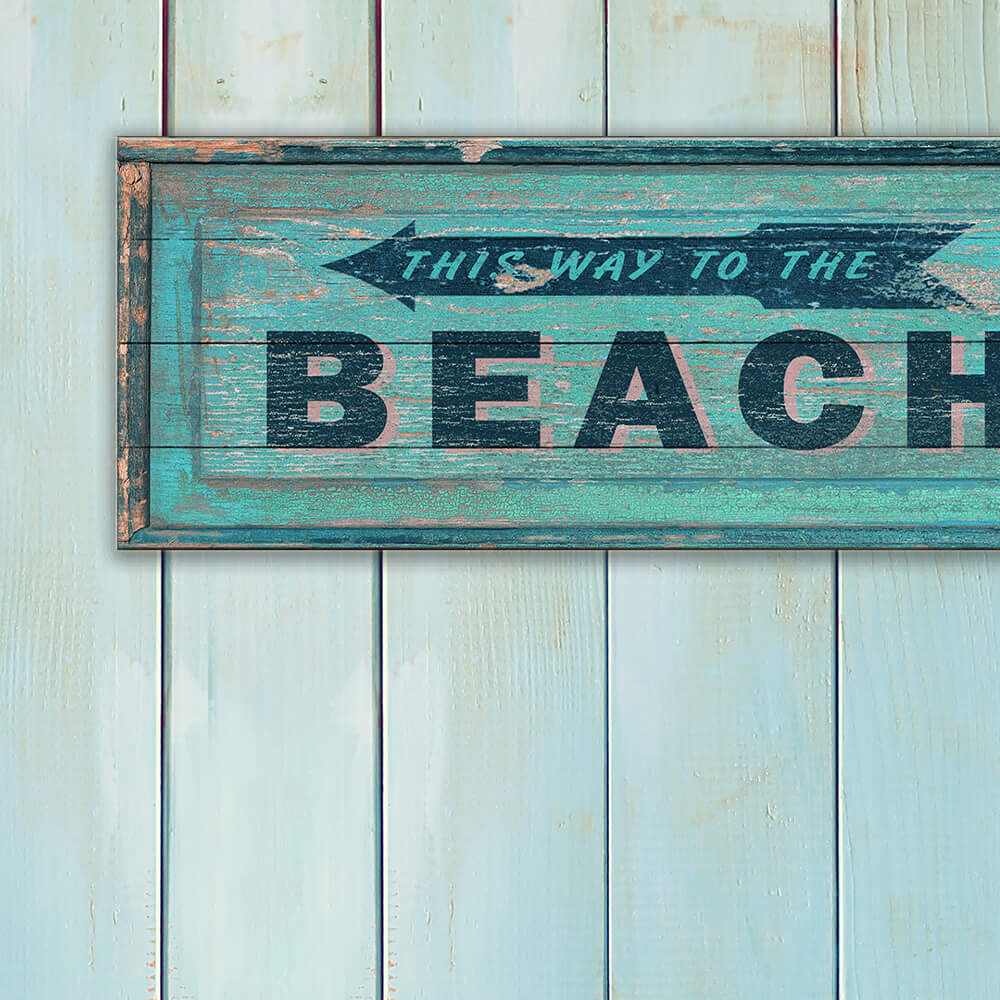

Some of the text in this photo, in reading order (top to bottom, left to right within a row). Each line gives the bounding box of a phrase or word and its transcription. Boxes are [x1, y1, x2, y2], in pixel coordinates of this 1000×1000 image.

[550, 249, 666, 281] WAY
[690, 249, 749, 281] TO
[780, 249, 878, 281] THE
